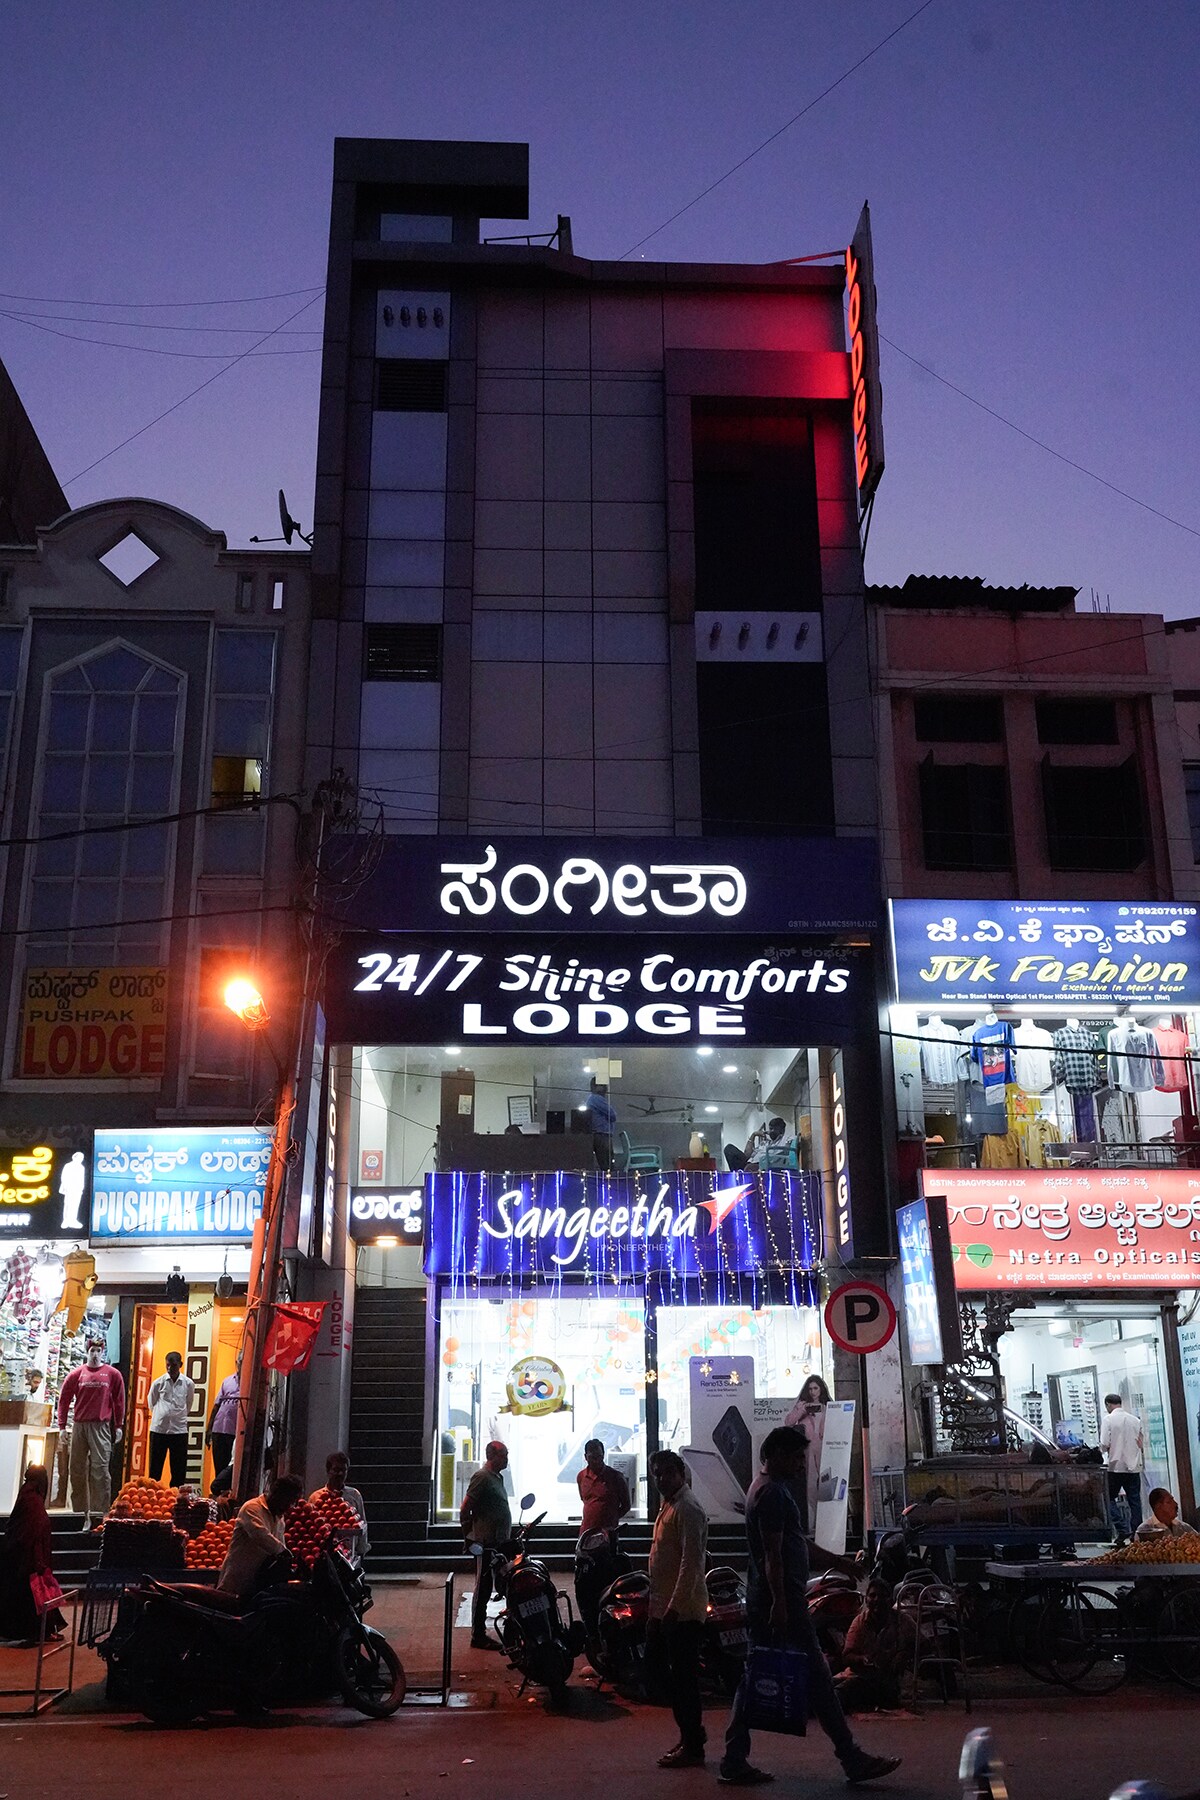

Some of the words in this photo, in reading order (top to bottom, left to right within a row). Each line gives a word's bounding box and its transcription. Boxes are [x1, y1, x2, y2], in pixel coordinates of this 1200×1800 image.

[846, 244, 869, 490] LODGE
[440, 844, 747, 916] ಸಂಗೀತಾ
[1131, 907, 1197, 915] 7892076159
[28, 970, 100, 1010] ಪುಷ್ಪಕ್
[353, 950, 484, 996] 24/7
[499, 954, 631, 1002] Shine
[640, 953, 850, 1002] Comforts
[1009, 954, 1188, 983] Fashion
[1061, 984, 1108, 992] Exclusive
[1159, 984, 1185, 992] Wear
[29, 1010, 134, 1022] PUSHPAK
[463, 1003, 746, 1036] LODGE
[24, 1024, 165, 1074] LODGE
[97, 1145, 188, 1184] ಪುಷ್ಪಕ್
[324, 1066, 337, 1246] LODGE
[833, 1072, 850, 1246] LODGE
[93, 1190, 199, 1233] PUSHPAK
[203, 1190, 267, 1232] LODG
[352, 1190, 423, 1233] ಲಾಡ್ಜ್
[482, 1183, 699, 1265] Sangeetha
[992, 1194, 1072, 1241] ನೇತ್ರ
[1009, 1249, 1081, 1264] Netra
[1094, 1249, 1200, 1267] Opticals
[1106, 1273, 1121, 1282] Eye
[1123, 1272, 1170, 1281] Examination
[1171, 1272, 1190, 1280] done
[188, 1300, 215, 1320] Pushpak
[330, 1290, 343, 1346] LODGE
[844, 1294, 880, 1341] P
